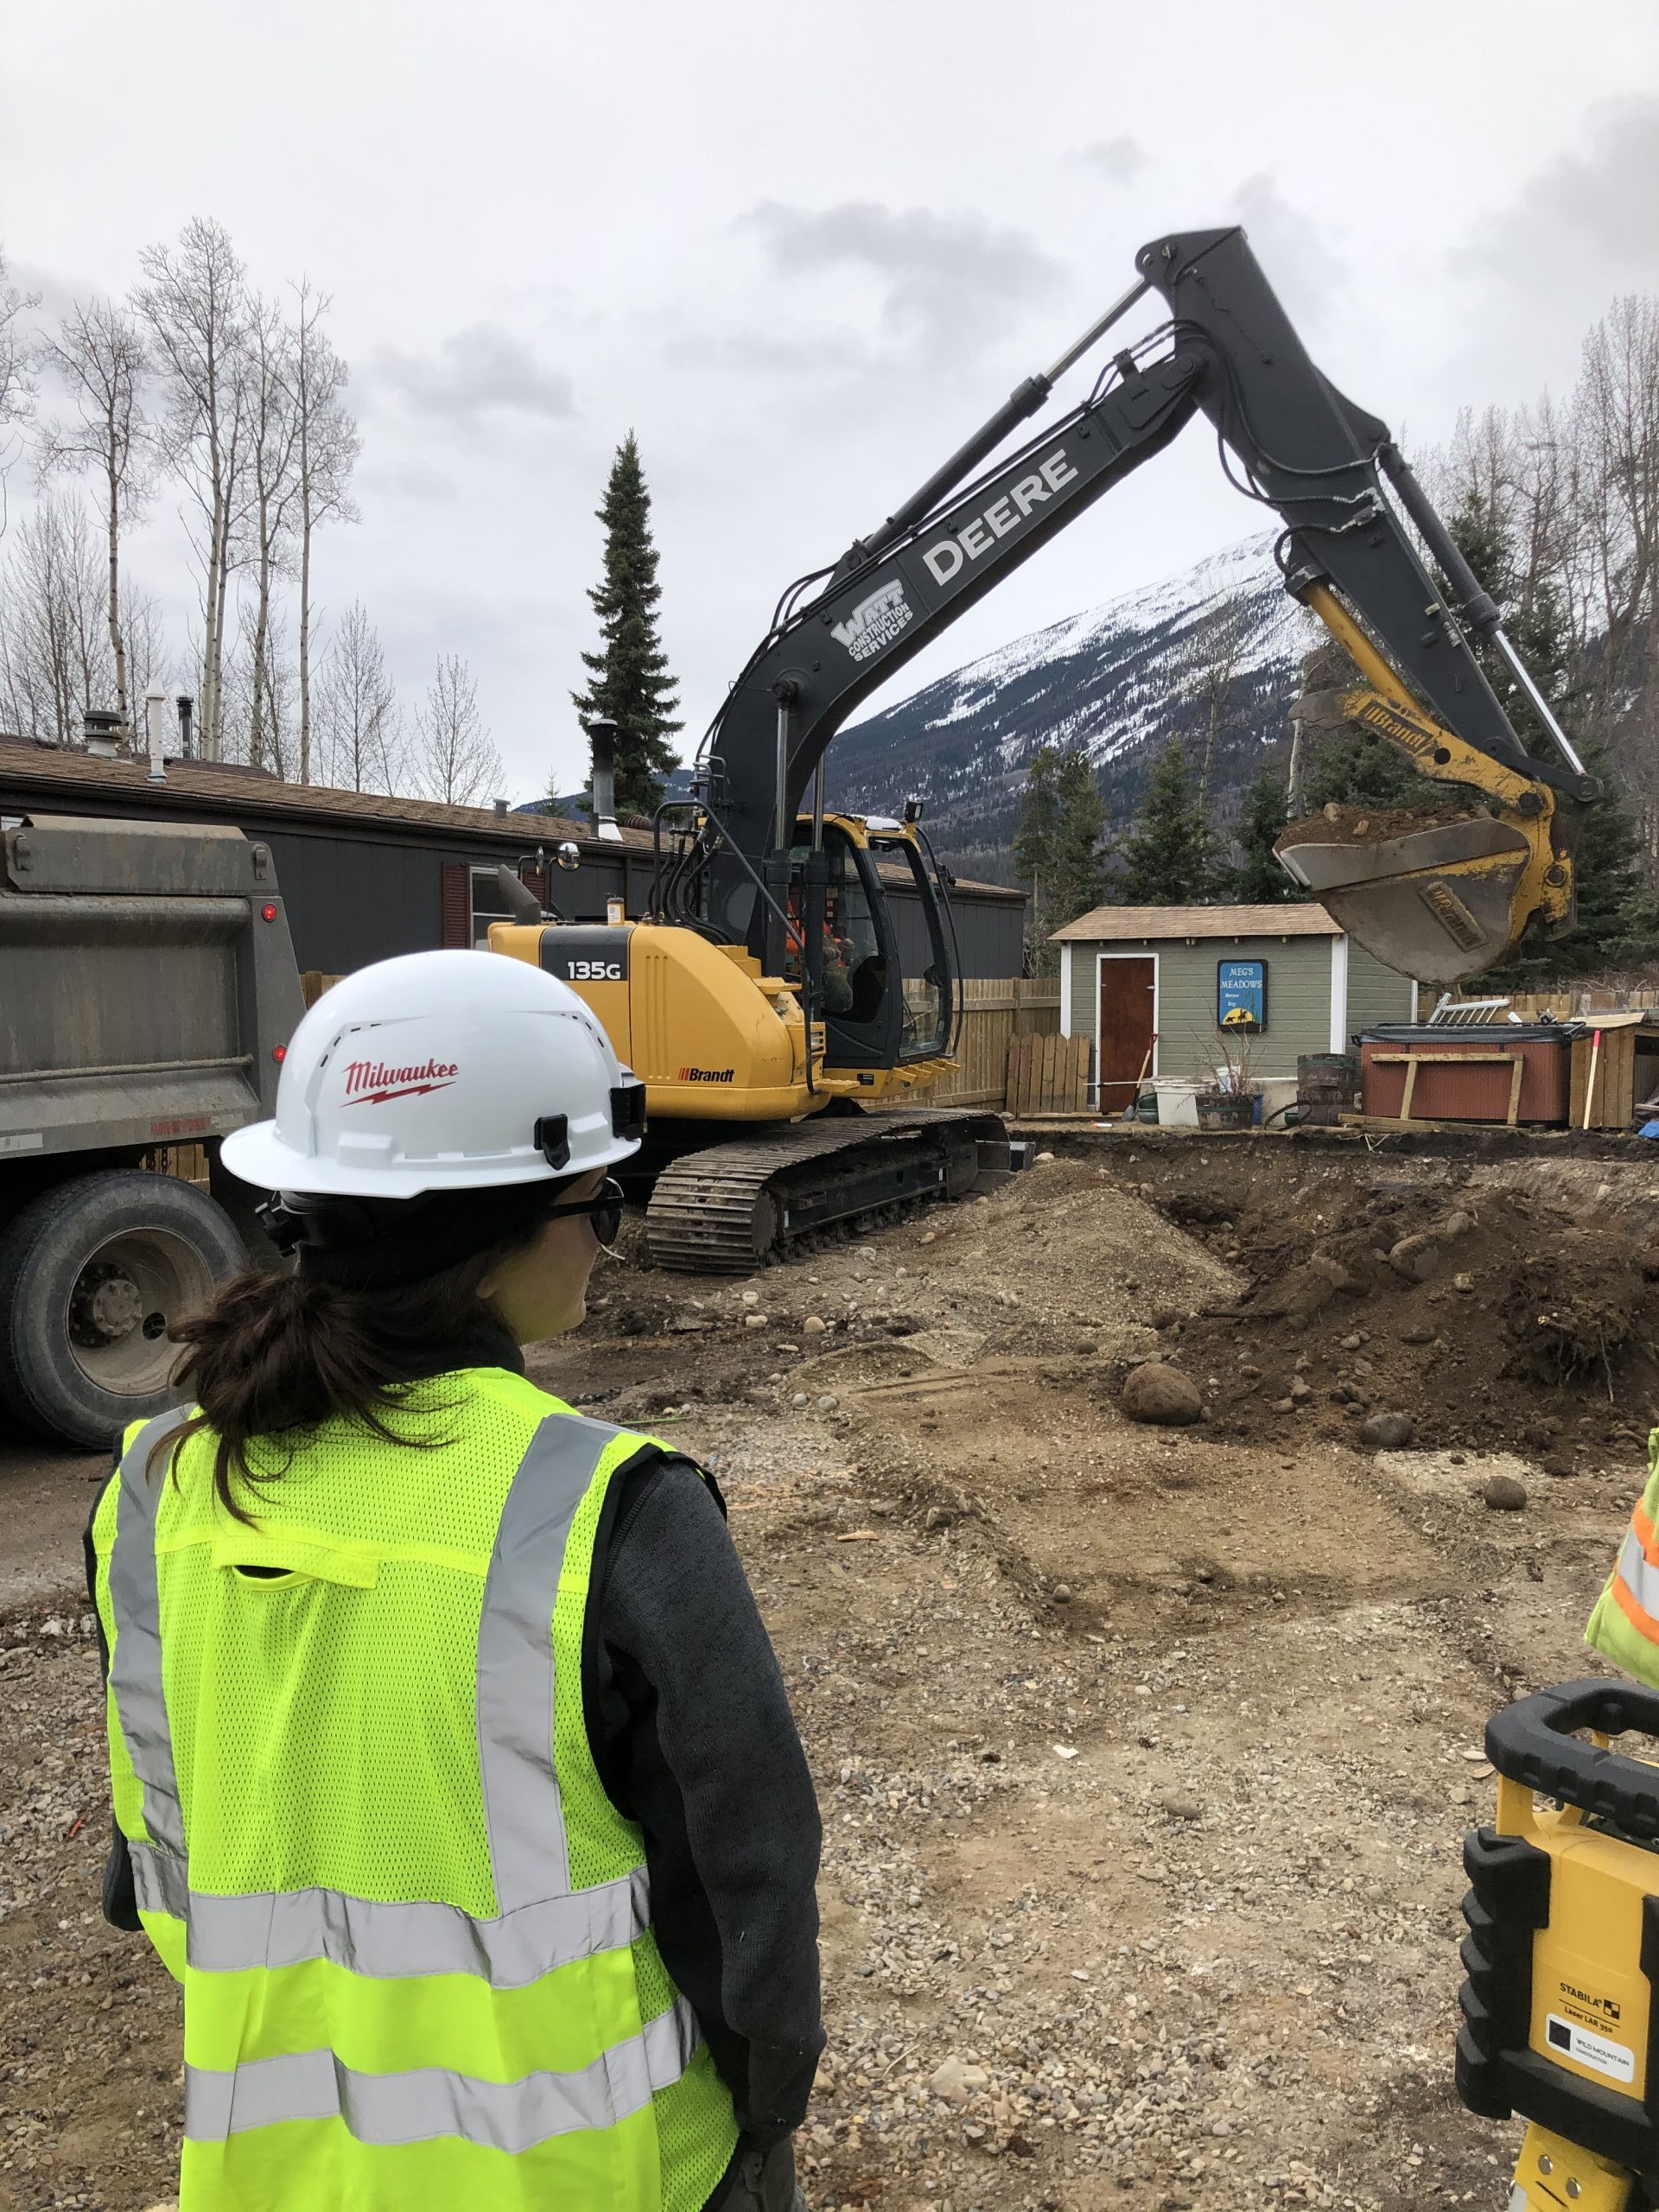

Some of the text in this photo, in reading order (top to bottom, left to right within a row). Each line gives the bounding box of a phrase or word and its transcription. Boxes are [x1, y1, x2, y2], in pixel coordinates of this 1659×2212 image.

[922, 448, 1079, 587] DEERE
[830, 578, 904, 648] WATT
[849, 602, 910, 657] CONSTRUCTION
[854, 610, 913, 662] SERVICES
[568, 961, 621, 980] 135G
[1230, 968, 1254, 976] MEG'S
[1220, 980, 1262, 989] MEADOWS
[340, 1058, 459, 1095] Milwaukee
[689, 1068, 734, 1083] Brandt
[1564, 2006, 1613, 2033] Laser LAR 350
[1592, 2046, 1630, 2066] MOUNTAIN
